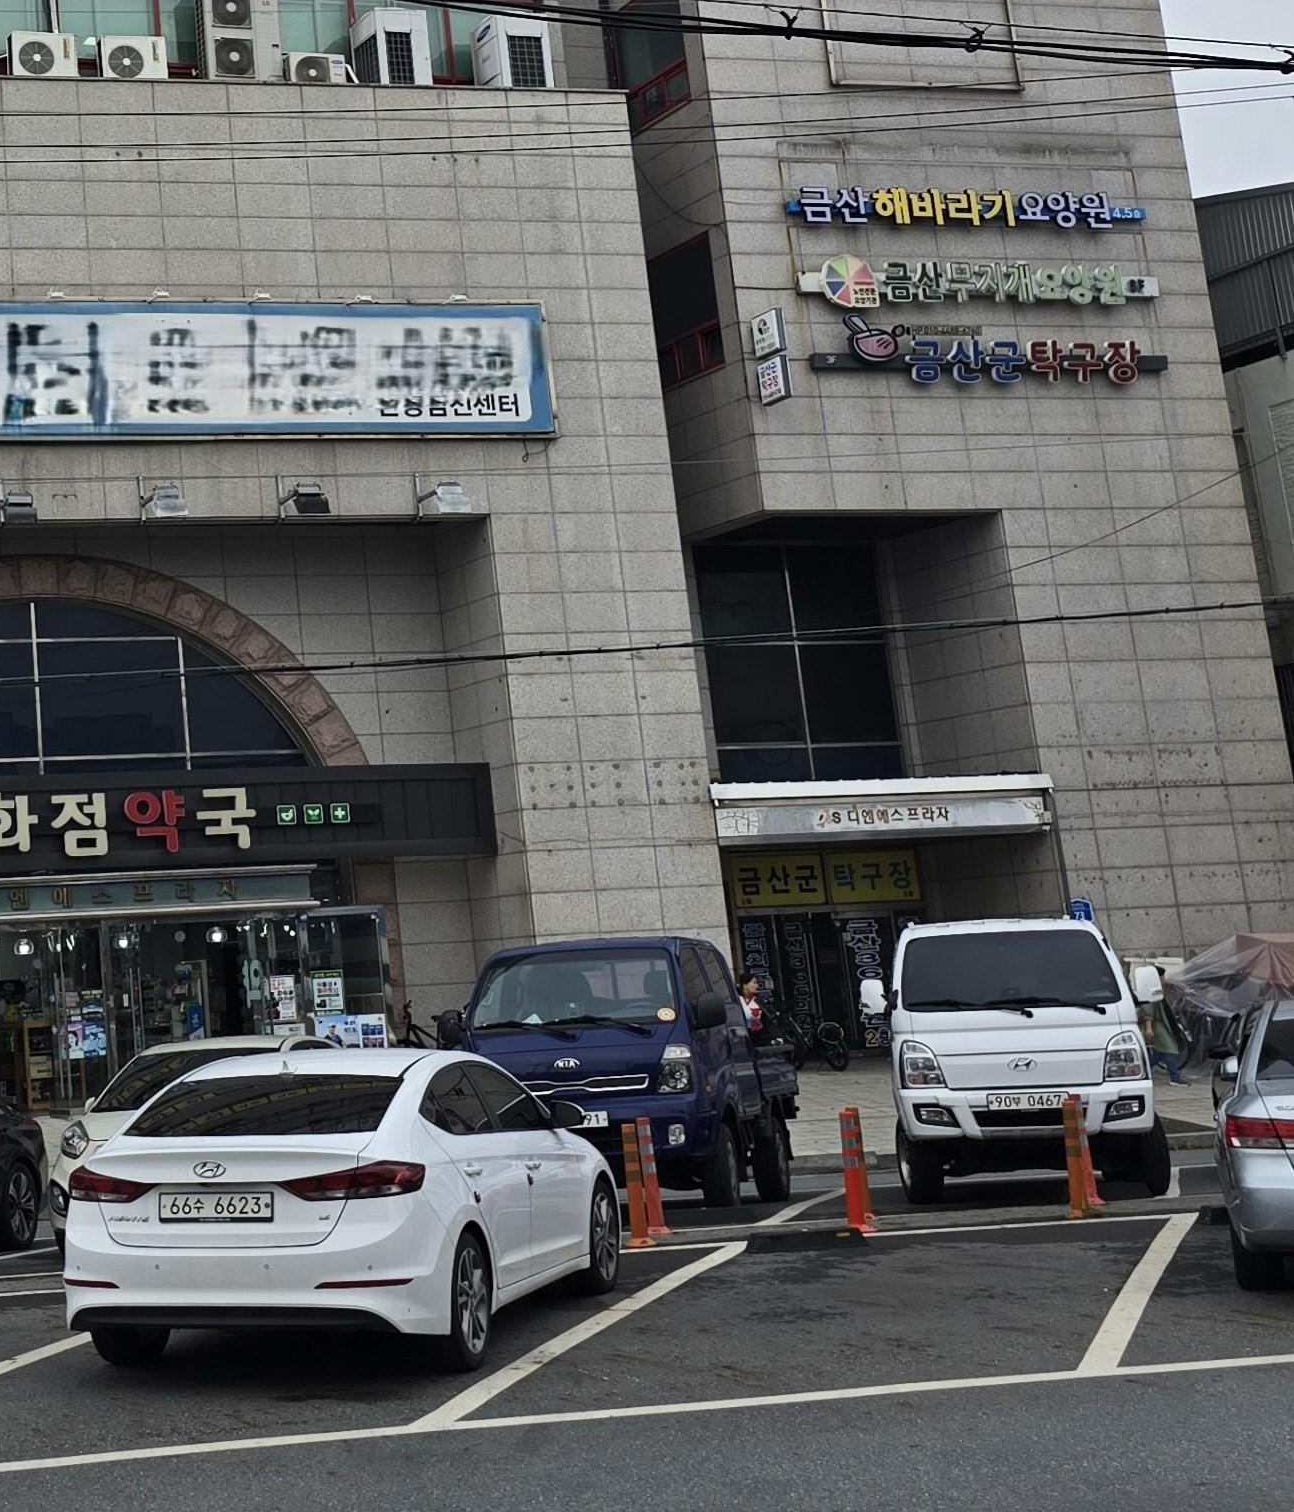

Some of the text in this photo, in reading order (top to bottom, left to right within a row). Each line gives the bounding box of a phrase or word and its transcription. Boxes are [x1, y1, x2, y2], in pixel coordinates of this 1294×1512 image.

[1027, 1094, 1062, 1107] 0467
[169, 1195, 262, 1216] 66수 6623
